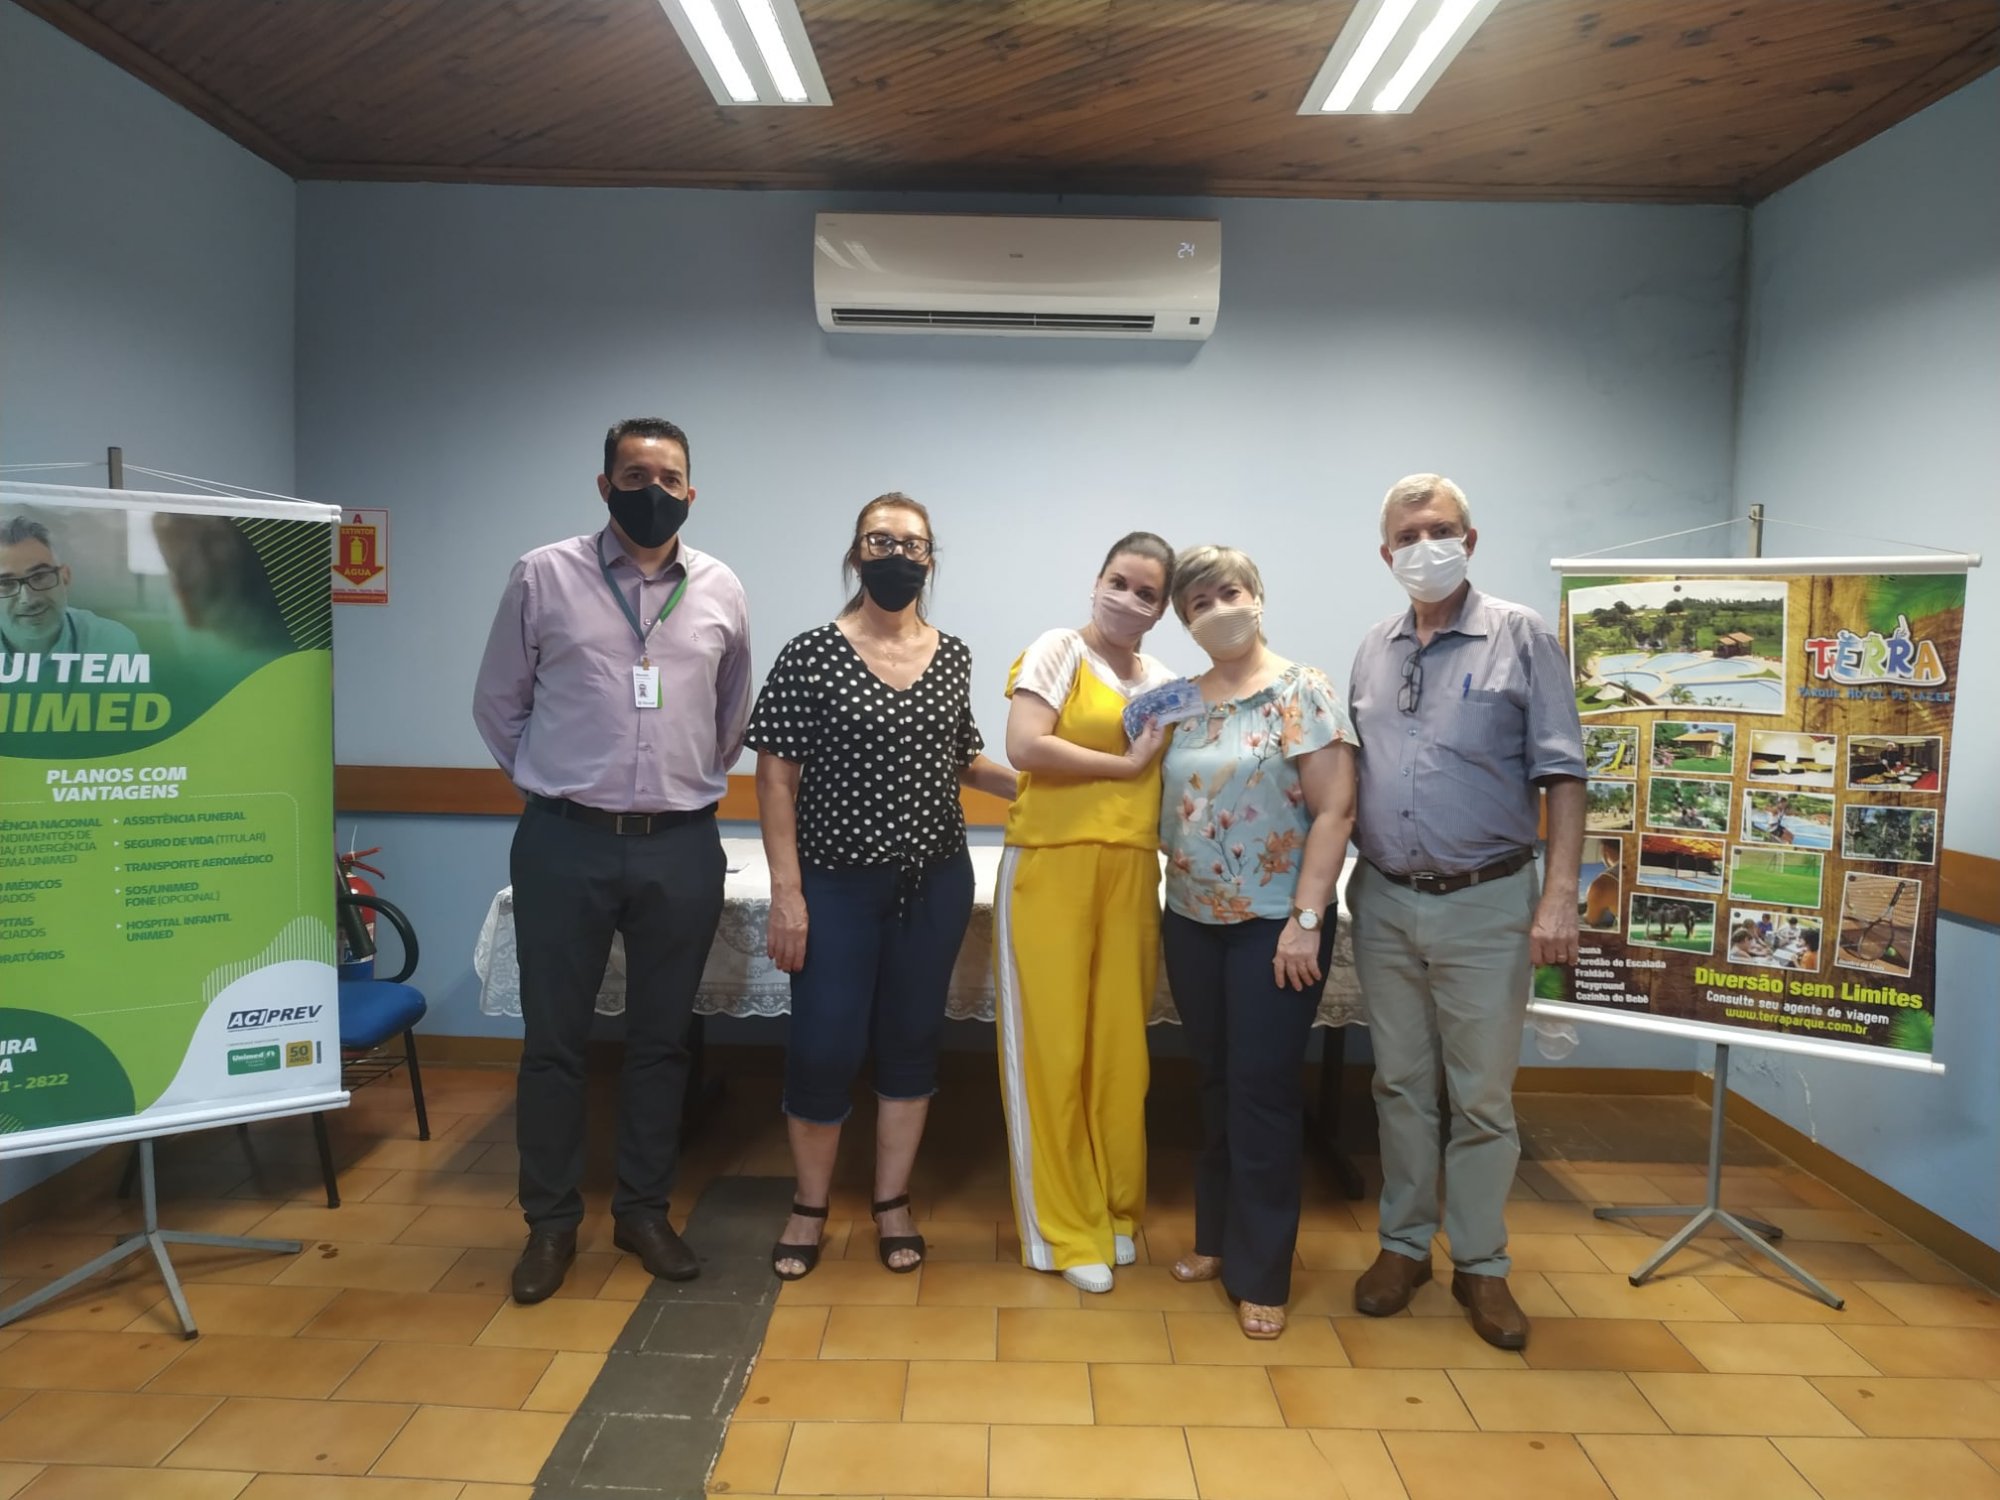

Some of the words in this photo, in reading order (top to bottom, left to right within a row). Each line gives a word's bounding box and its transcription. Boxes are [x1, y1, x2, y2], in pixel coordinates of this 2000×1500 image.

[1178, 242, 1195, 258] 24
[51, 653, 150, 683] TEM
[46, 768, 134, 784] PLANOS
[139, 767, 187, 782] COM
[52, 784, 179, 802] VANTAGENS
[40, 818, 103, 829] NACIONAL
[123, 813, 196, 826] ASSISTÊNCIA
[197, 811, 246, 823] FUNERAL
[76, 830, 92, 840] DE
[124, 838, 171, 849] SEGURO
[173, 837, 186, 847] DE
[188, 835, 214, 846] VIDA
[215, 832, 266, 844] (TITULAR)
[28, 855, 77, 865] UNIMED
[125, 859, 200, 872] TRANSPORTE
[202, 853, 273, 867] AEROMÉDICO
[5, 878, 62, 891] MÉDICOS
[125, 882, 199, 895] SOS/UNIMED
[125, 896, 156, 907] FONE
[158, 891, 220, 906] (OPCIONAL)
[126, 917, 181, 930] HOSPITAL
[183, 913, 232, 926] INFANTIL
[126, 929, 173, 941] UNIMED
[1626, 958, 1666, 969] Escalada
[1574, 968, 1615, 978] Fraldário
[1575, 980, 1625, 991] Playground
[1695, 966, 1783, 994] Diversão
[1789, 982, 1834, 999] sem
[1841, 982, 1923, 1009] Limites
[1576, 992, 1610, 1002] Cozinha
[1625, 993, 1649, 1004] Bebê
[1706, 990, 1754, 1007] Consulte
[1758, 999, 1779, 1010] seu
[1783, 1001, 1823, 1016] agente
[1827, 1006, 1841, 1018] de
[1846, 1009, 1889, 1025] viagem
[227, 1005, 323, 1029] ACIPREV
[1725, 1007, 1868, 1035] www.terraparque.com.br
[232, 1051, 264, 1062] Unimed
[290, 1045, 309, 1058] 50
[25, 1073, 69, 1089] 2822
